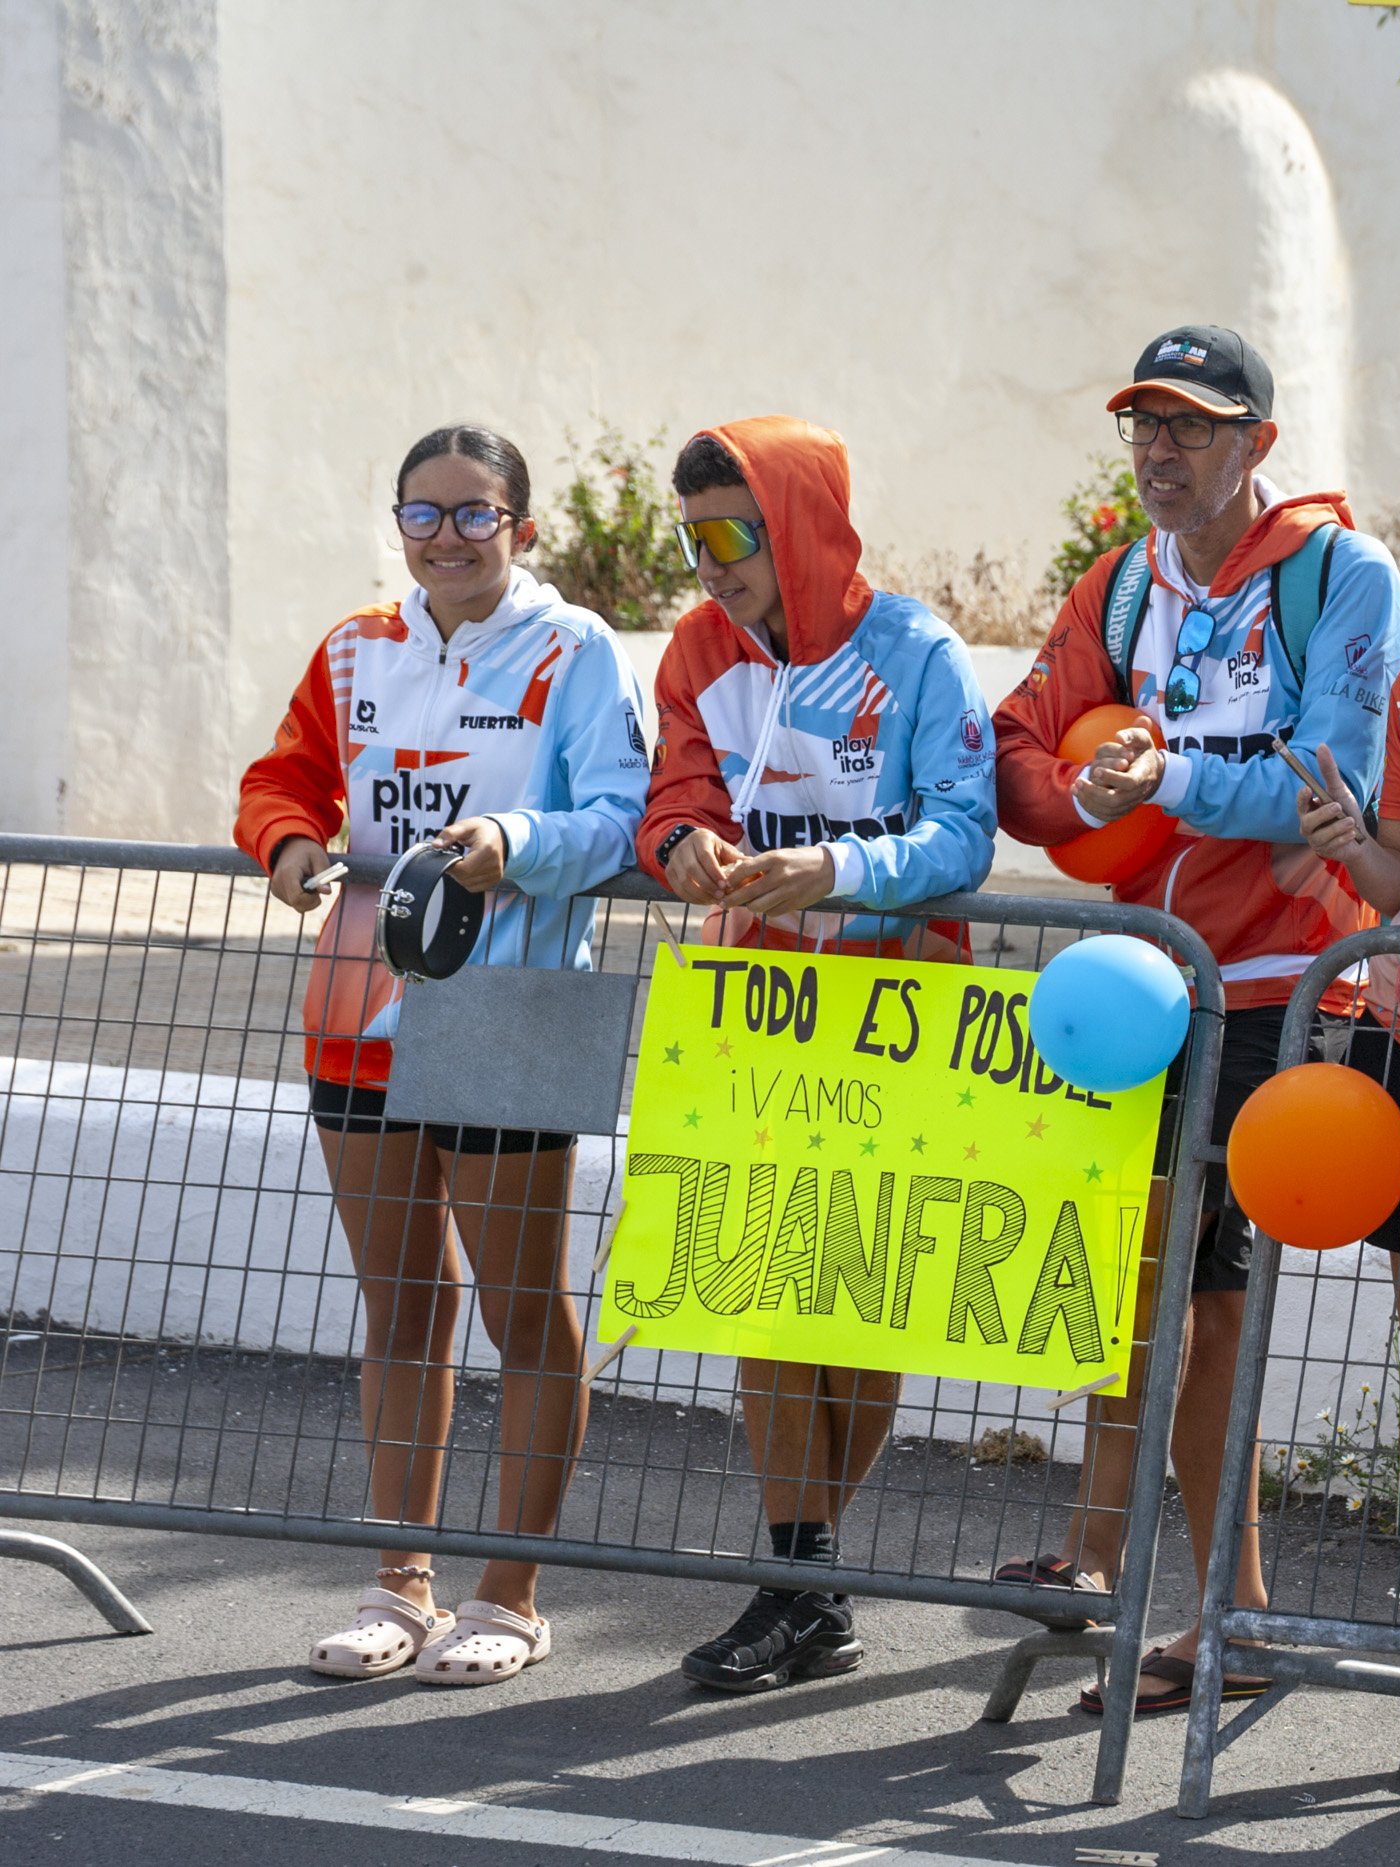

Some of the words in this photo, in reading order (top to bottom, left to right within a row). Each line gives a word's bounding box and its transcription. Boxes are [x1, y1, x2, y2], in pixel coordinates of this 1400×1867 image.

[1107, 543, 1148, 664] FUERTEVENTUR
[1227, 651, 1262, 678] play
[1235, 671, 1260, 690] itas
[1355, 687, 1386, 712] BIKE
[460, 715, 524, 730] FUERTRI
[832, 735, 873, 760] play
[840, 755, 875, 773] itas
[373, 770, 471, 827] play
[692, 960, 818, 1043] TODO
[853, 977, 922, 1063] ES
[949, 984, 1112, 1111] POSI
[615, 1152, 1140, 1364] JUANFRA!
